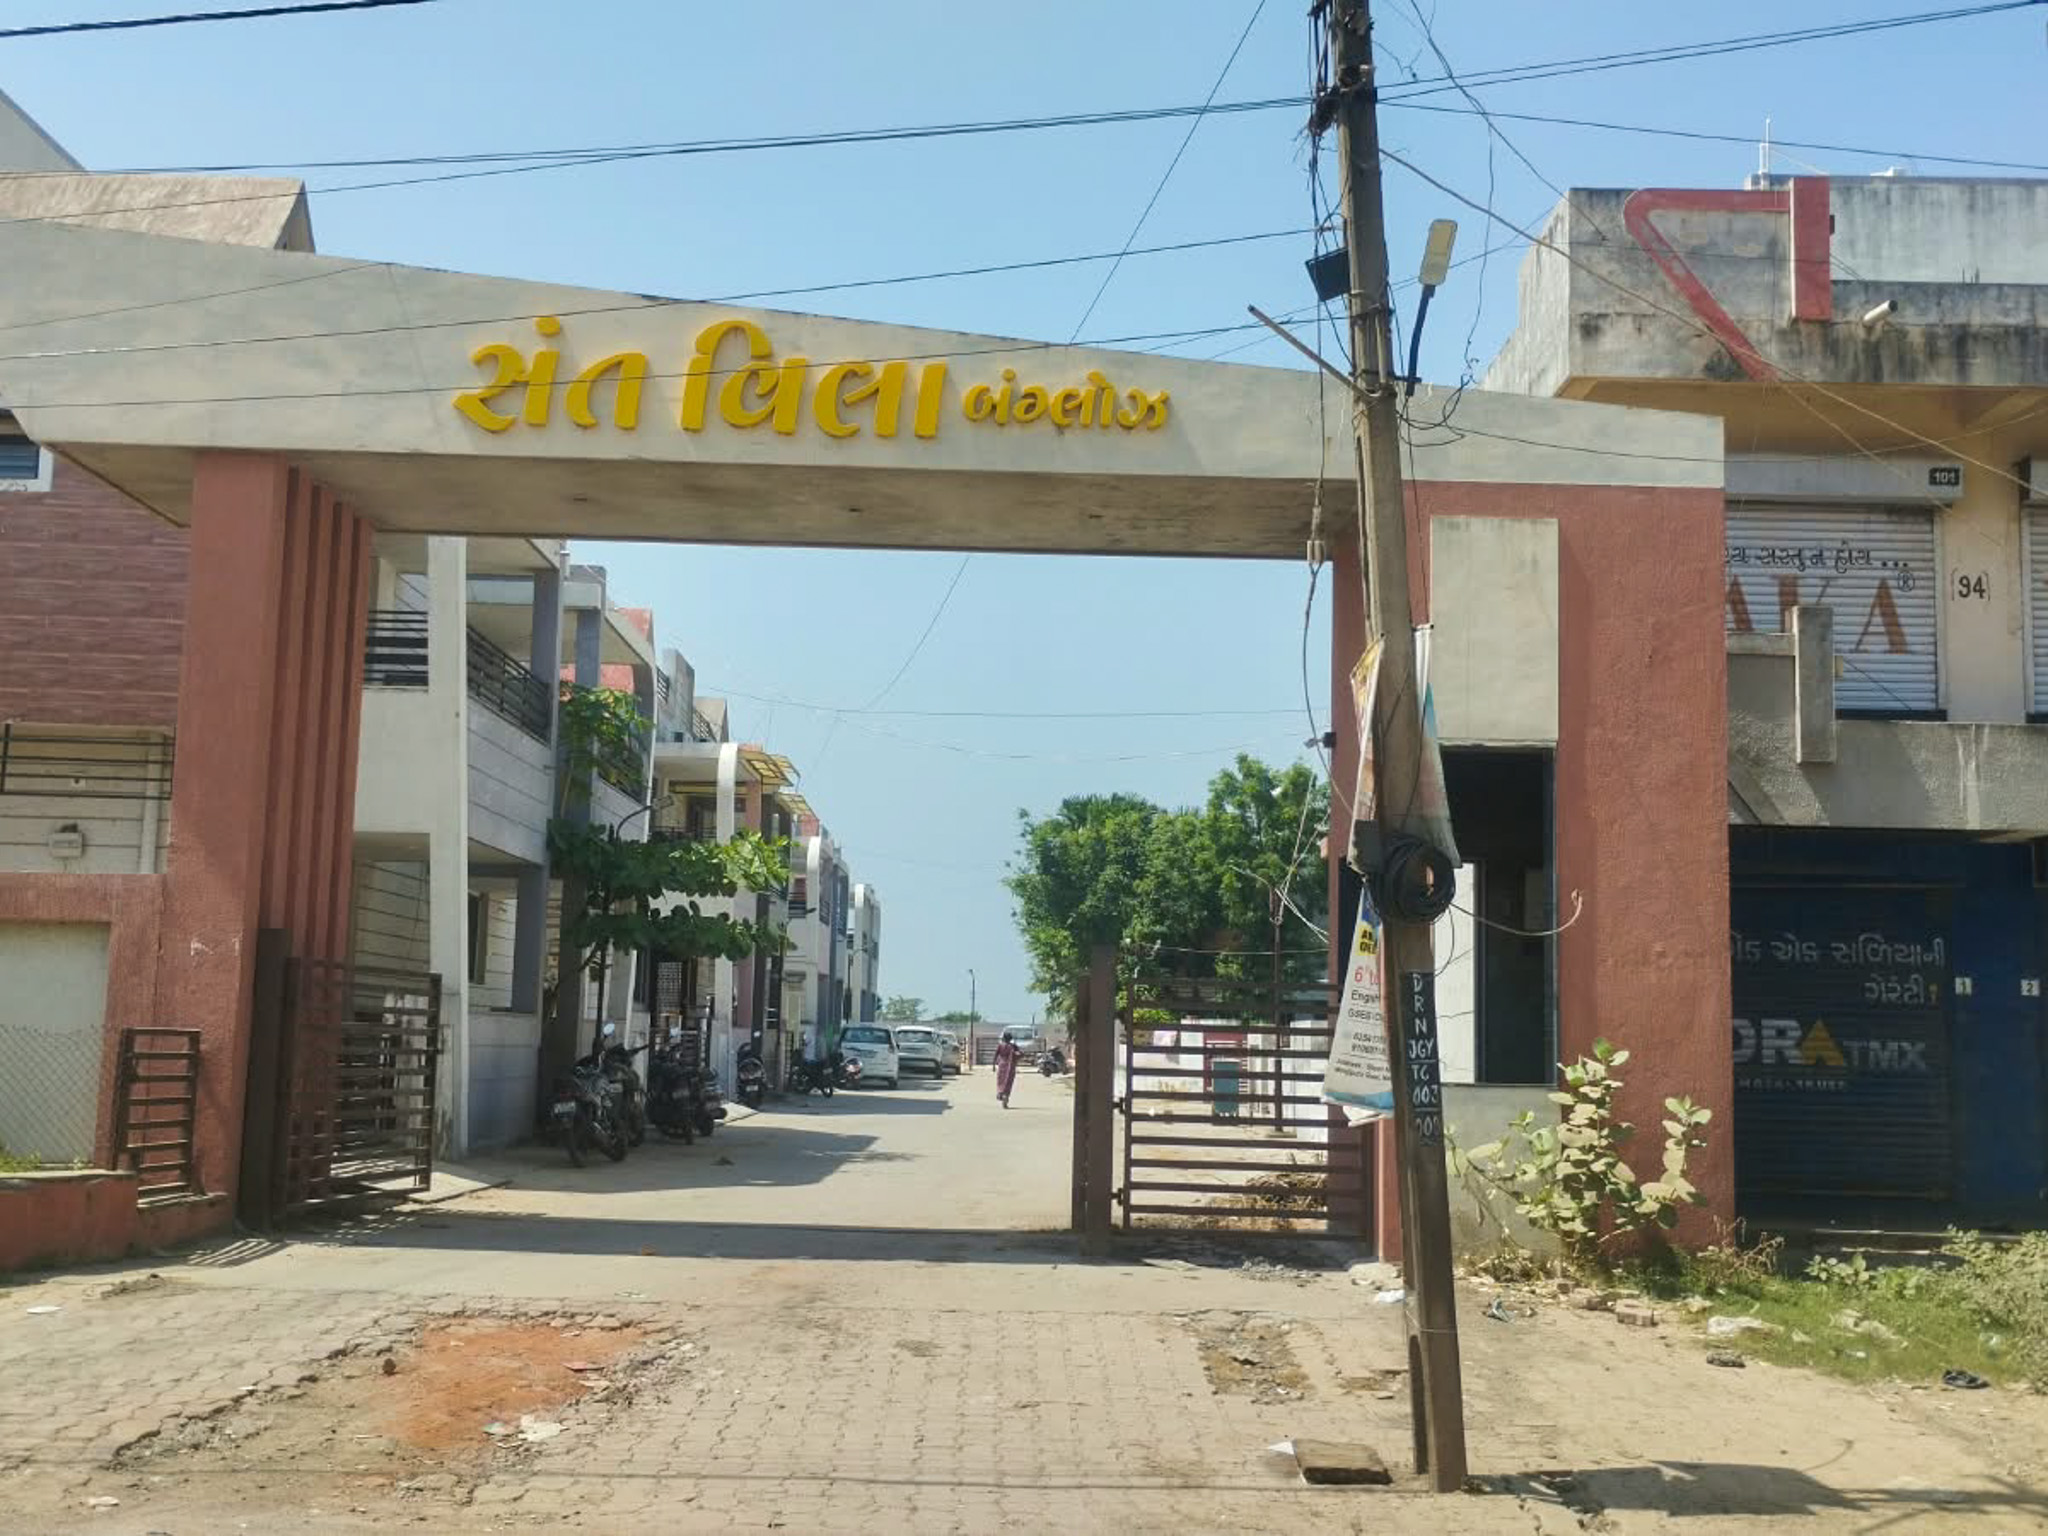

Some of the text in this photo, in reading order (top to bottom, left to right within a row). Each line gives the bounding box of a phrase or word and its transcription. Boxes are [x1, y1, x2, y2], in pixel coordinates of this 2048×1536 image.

[452, 315, 645, 433] સંત
[679, 319, 948, 439] વિલા
[1843, 1040, 1927, 1071] TMX
